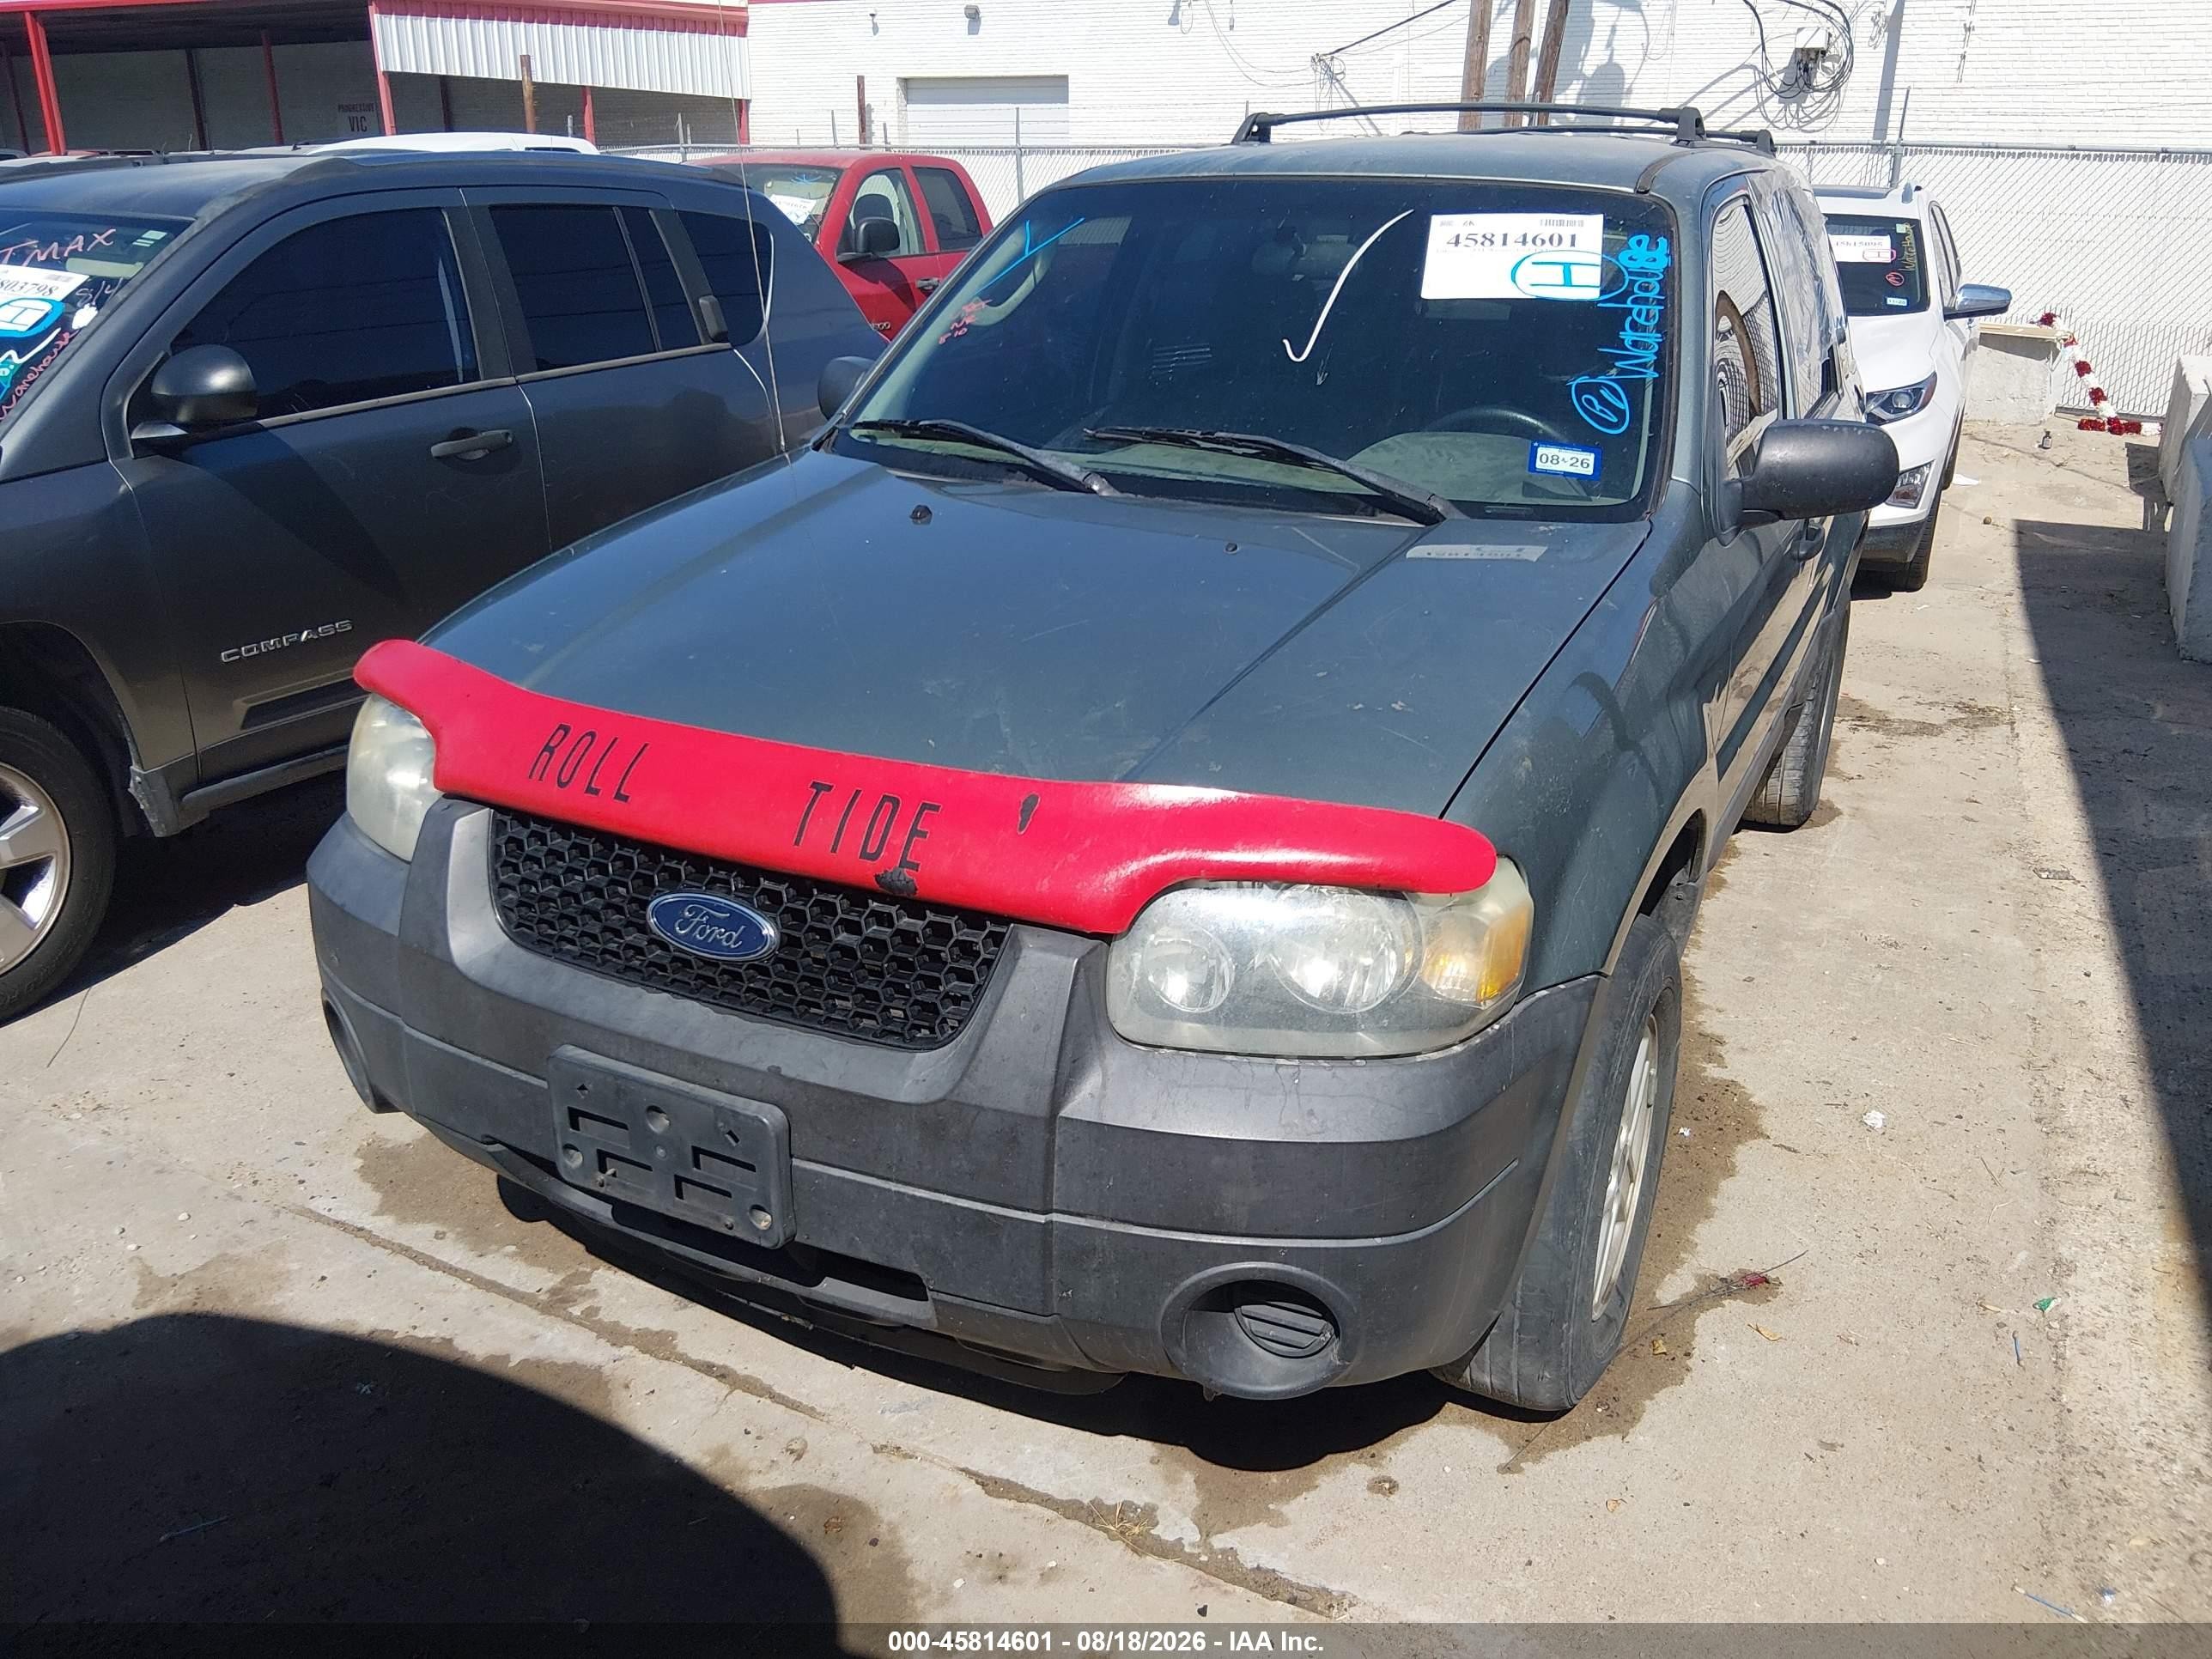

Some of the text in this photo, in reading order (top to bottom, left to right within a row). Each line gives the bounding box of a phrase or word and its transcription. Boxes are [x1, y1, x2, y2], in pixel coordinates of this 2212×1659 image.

[348, 115, 368, 132] VIC
[1446, 232, 1577, 248] 45814601
[1597, 234, 1672, 379] Warehouse
[1539, 453, 1590, 469] 08 26
[221, 619, 354, 663] COMPASS
[528, 723, 650, 804] ROLL
[793, 781, 943, 871] TIDE
[674, 903, 746, 949] Ford
